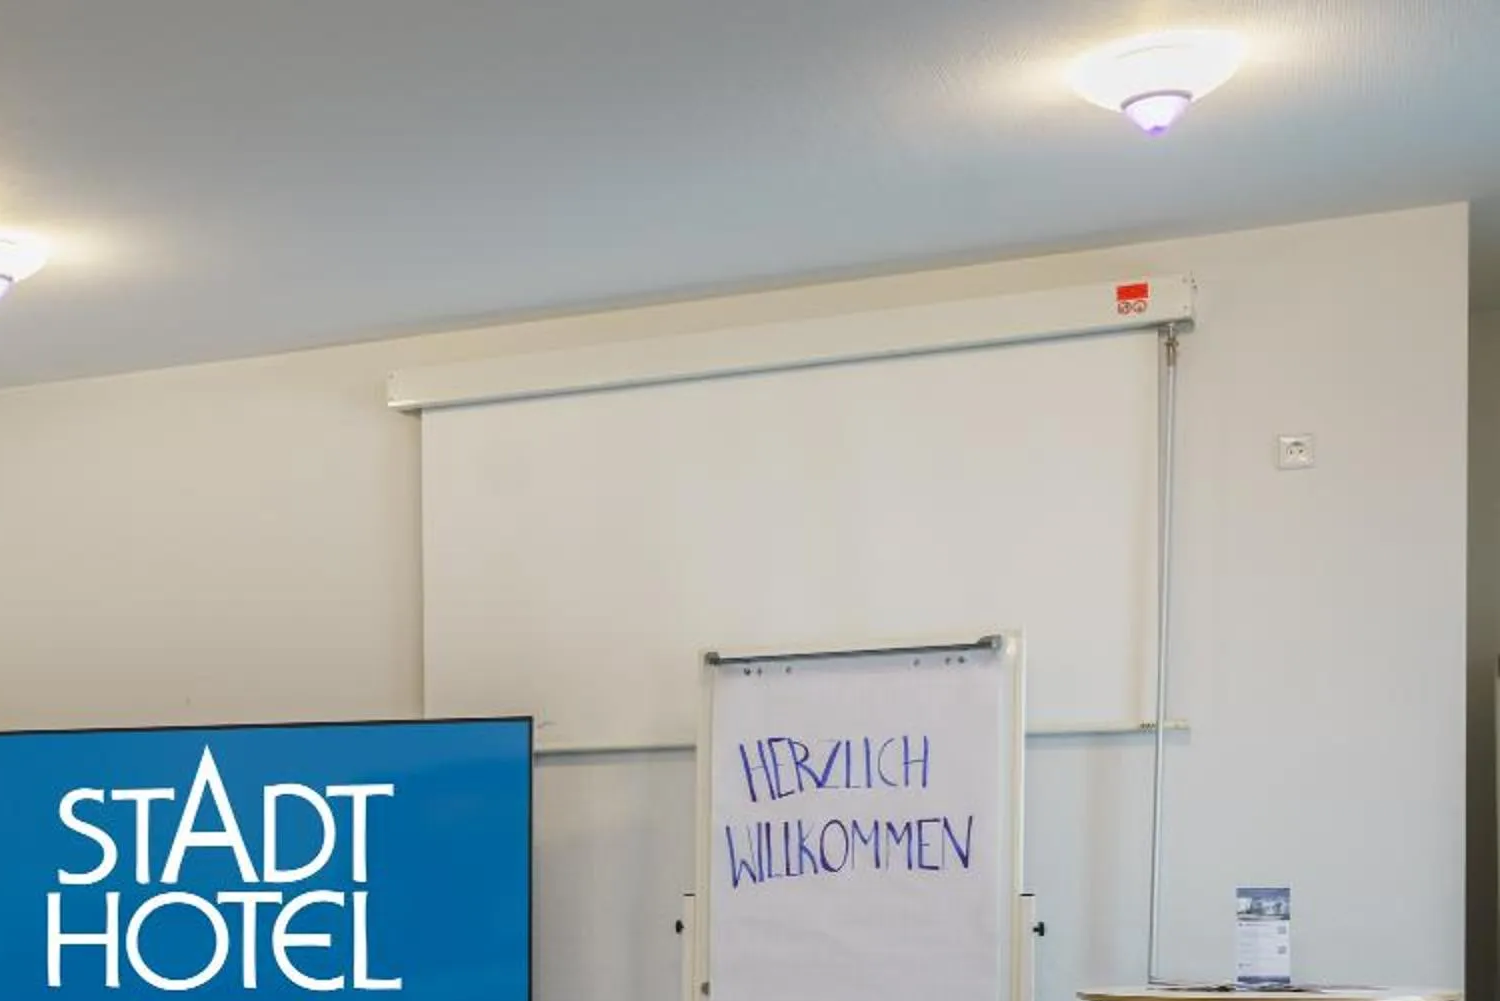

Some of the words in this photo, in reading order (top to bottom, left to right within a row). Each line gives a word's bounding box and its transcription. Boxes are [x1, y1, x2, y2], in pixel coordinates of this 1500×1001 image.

[739, 736, 929, 802] HERZLICH
[57, 745, 394, 884] STADT
[725, 816, 973, 889] WILLKOMMEN
[46, 890, 402, 990] HOTEL
